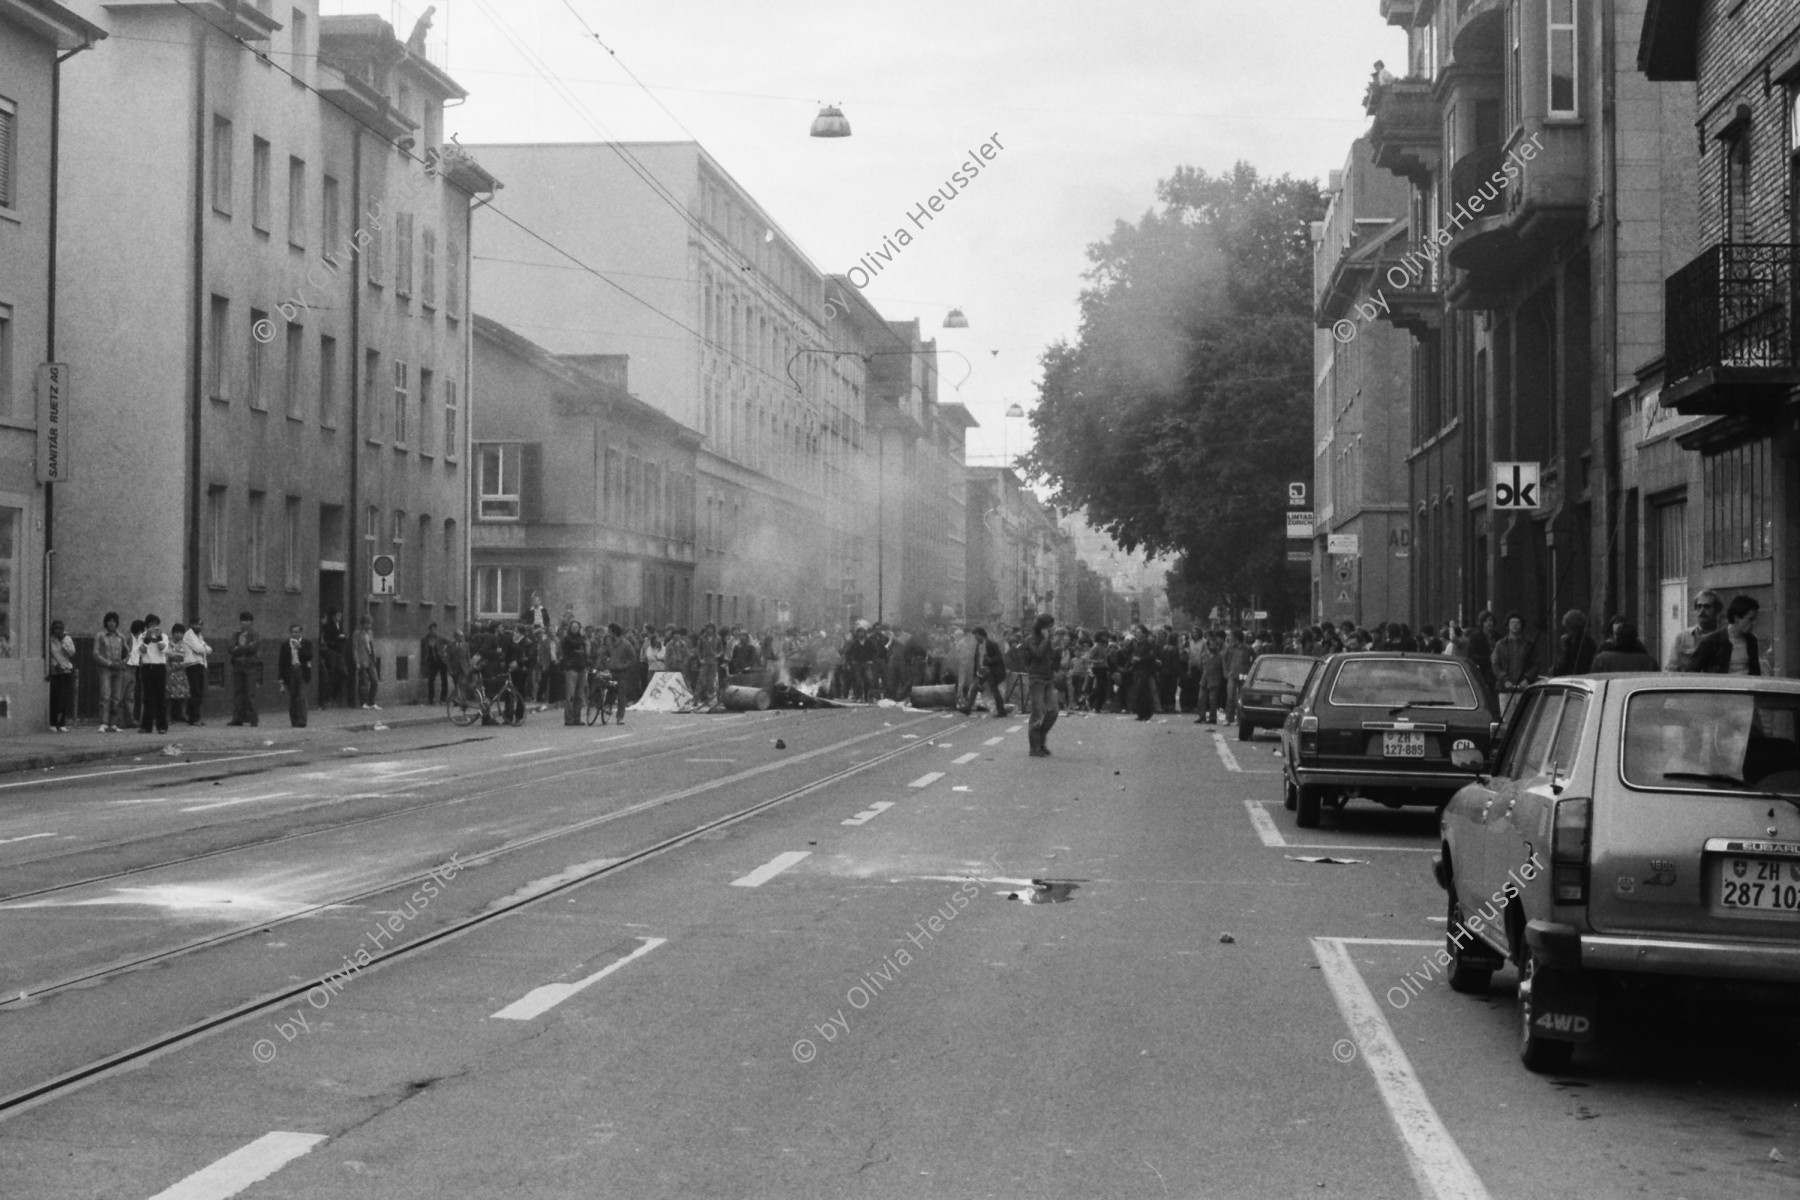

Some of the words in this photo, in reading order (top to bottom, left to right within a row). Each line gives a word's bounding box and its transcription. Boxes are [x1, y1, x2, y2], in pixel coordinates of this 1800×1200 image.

[50, 367, 59, 383] AG
[49, 386, 59, 423] RUETZ
[48, 428, 58, 477] SANITÄR
[1397, 733, 1411, 743] ZH
[1757, 862, 1780, 881] ZH
[1723, 881, 1765, 906] 287
[1535, 1012, 1590, 1033] 4WD
